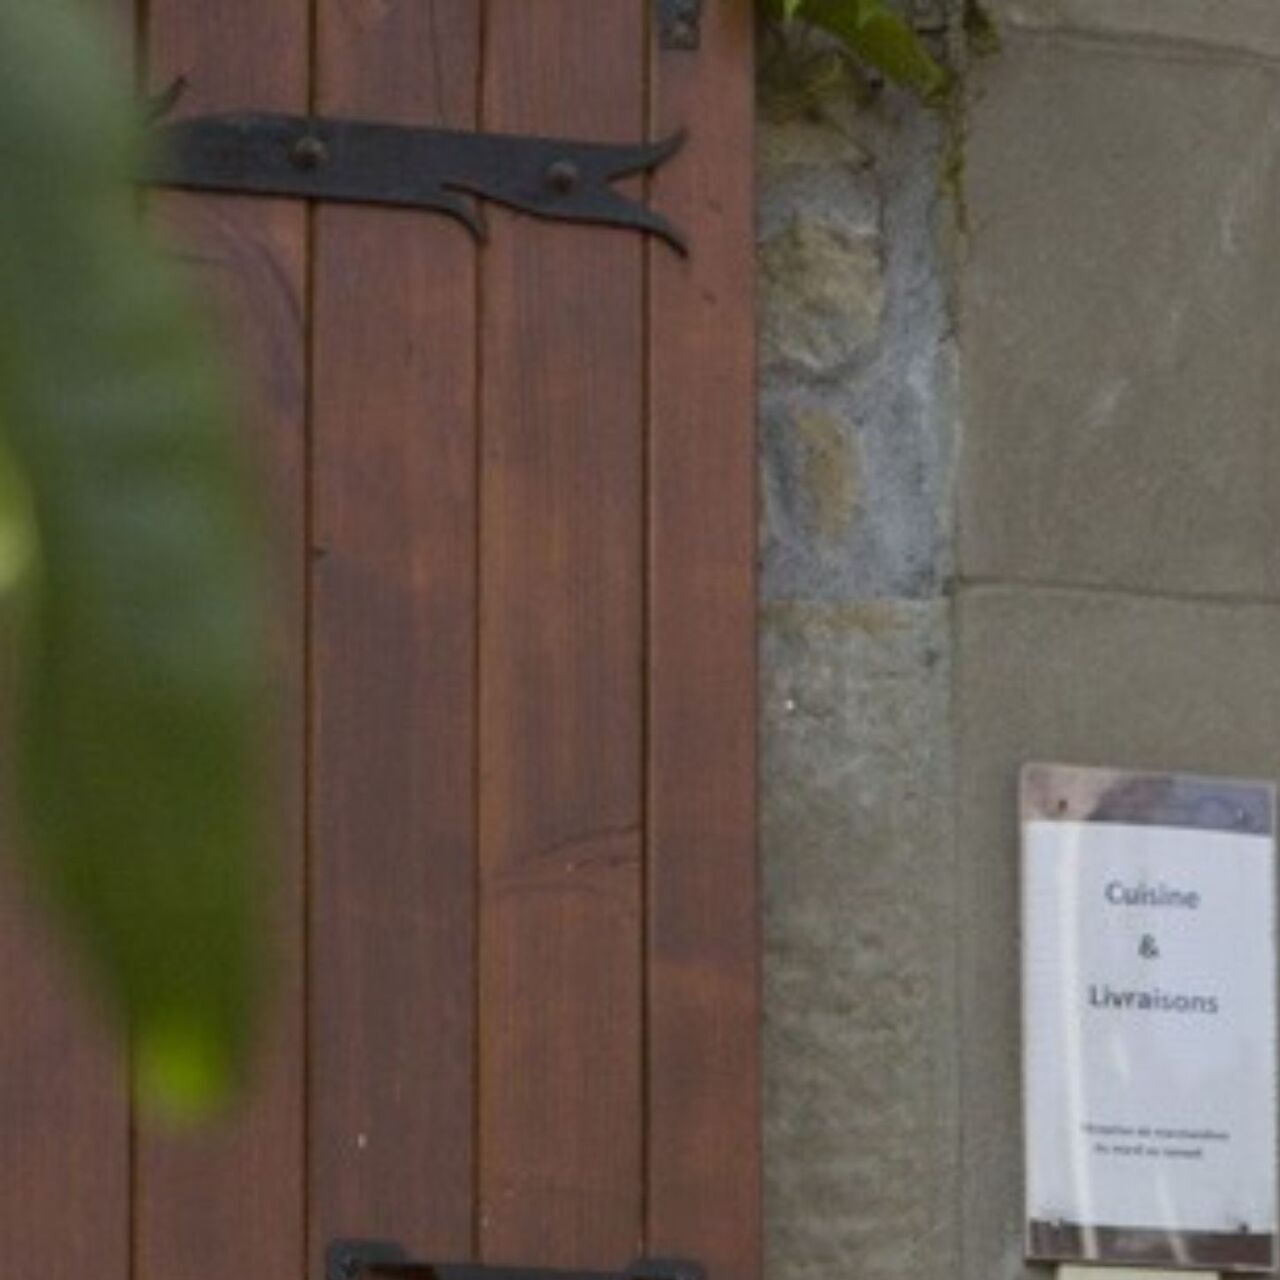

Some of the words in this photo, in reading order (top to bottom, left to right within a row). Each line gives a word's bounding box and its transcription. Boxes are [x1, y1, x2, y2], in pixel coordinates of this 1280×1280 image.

[1104, 880, 1200, 909] Cuisine
[1138, 933, 1159, 960] &
[1088, 984, 1219, 1014] Livraisons
